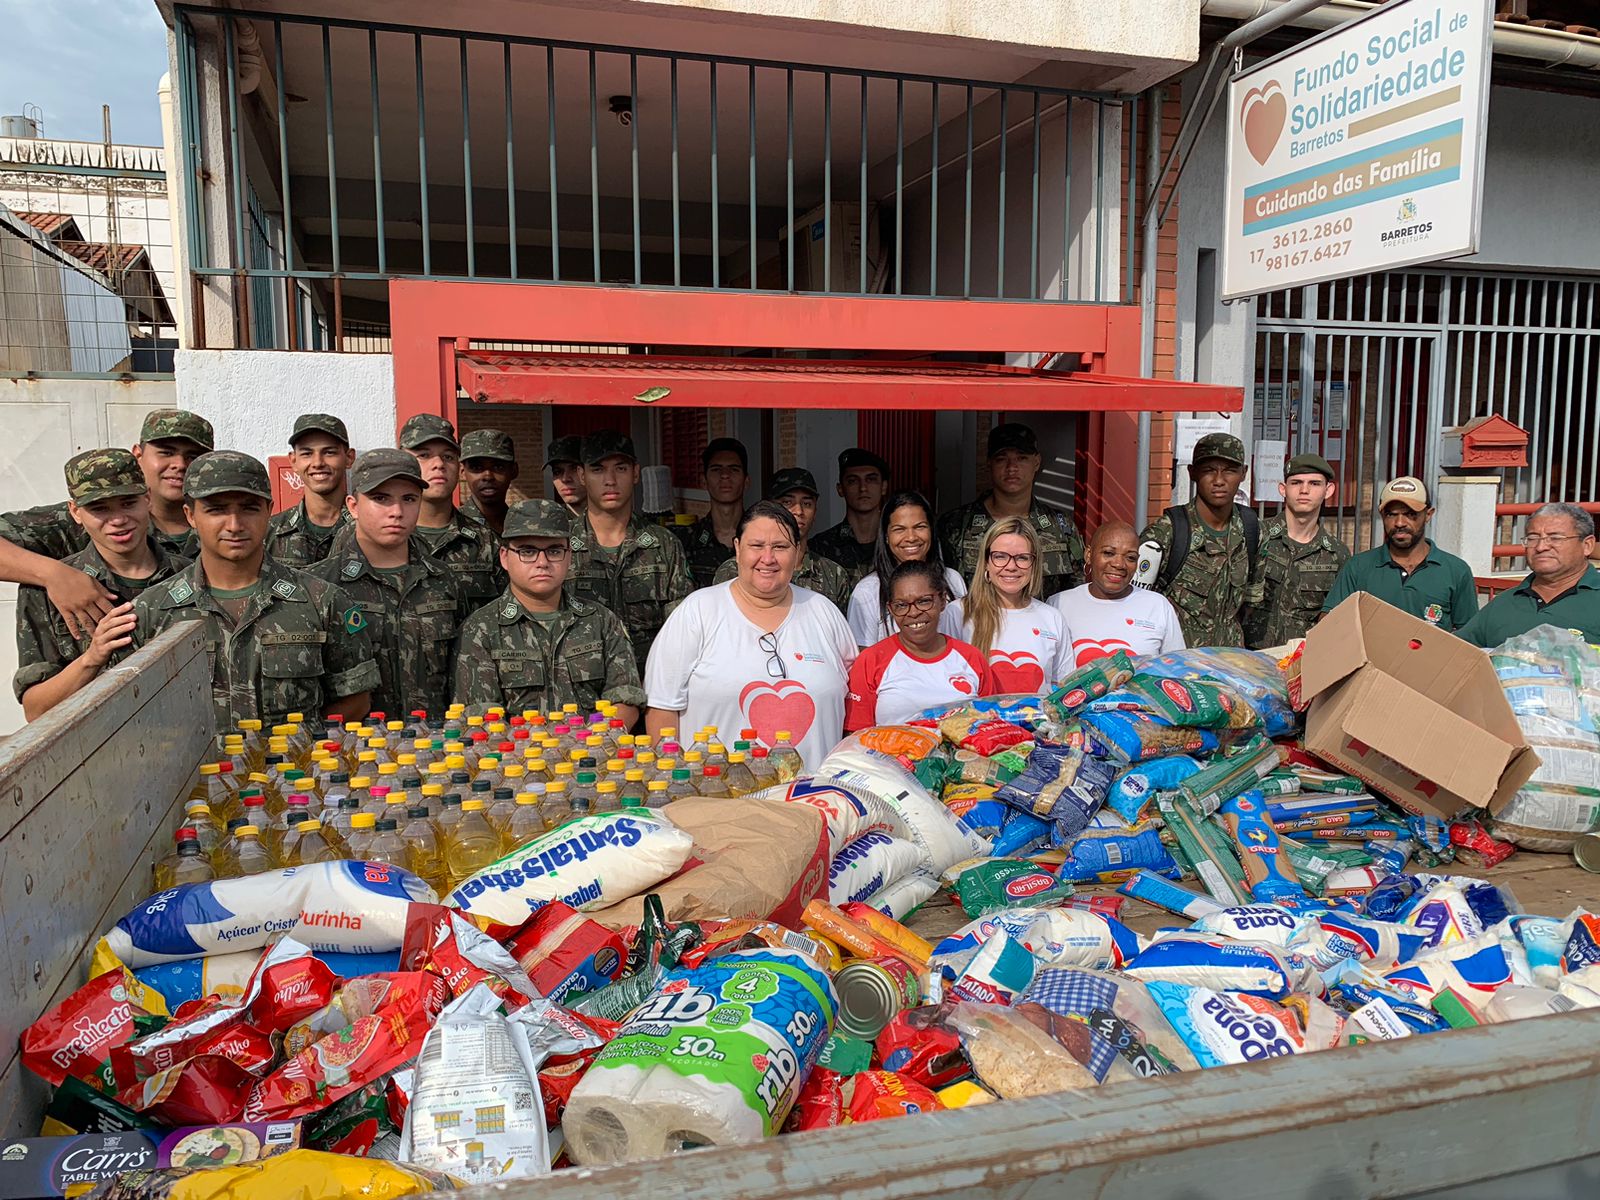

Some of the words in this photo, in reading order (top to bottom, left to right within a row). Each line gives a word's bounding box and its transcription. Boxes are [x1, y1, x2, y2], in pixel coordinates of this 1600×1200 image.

[1293, 52, 1359, 97] Fundo
[1366, 8, 1441, 66] Social
[1449, 12, 1469, 33] de
[1290, 49, 1465, 135] Solidariedade
[1290, 128, 1344, 159] Barretos
[1256, 182, 1328, 217] Cuidando
[1332, 173, 1363, 201] das
[1369, 148, 1442, 186] Família
[1272, 217, 1353, 250] 3612.2860
[1380, 222, 1433, 242] BARRETOS
[1383, 233, 1430, 248] PREFEITURA
[1250, 249, 1264, 264] 17
[1265, 240, 1352, 272] 98167.6427
[1320, 748, 1373, 785] EMPILHAMENTO
[1250, 845, 1278, 854] GALO
[1011, 876, 1050, 893] BASILAR
[217, 925, 261, 941] Açúcar
[1235, 915, 1295, 931] Dona
[1523, 925, 1561, 941] Sal
[1330, 934, 1355, 950] Rosa
[274, 979, 315, 1004] Molho
[737, 977, 758, 993] 4
[719, 1008, 743, 1016] 100%
[1365, 1009, 1392, 1040] closeup
[52, 1003, 133, 1068] Predilecta
[787, 1011, 818, 1047] 30m
[1203, 996, 1270, 1063] Dona
[219, 1038, 250, 1059] olho
[672, 1036, 725, 1061] 30m
[61, 1147, 151, 1173] Carr's
[61, 1172, 97, 1183] TABLE
